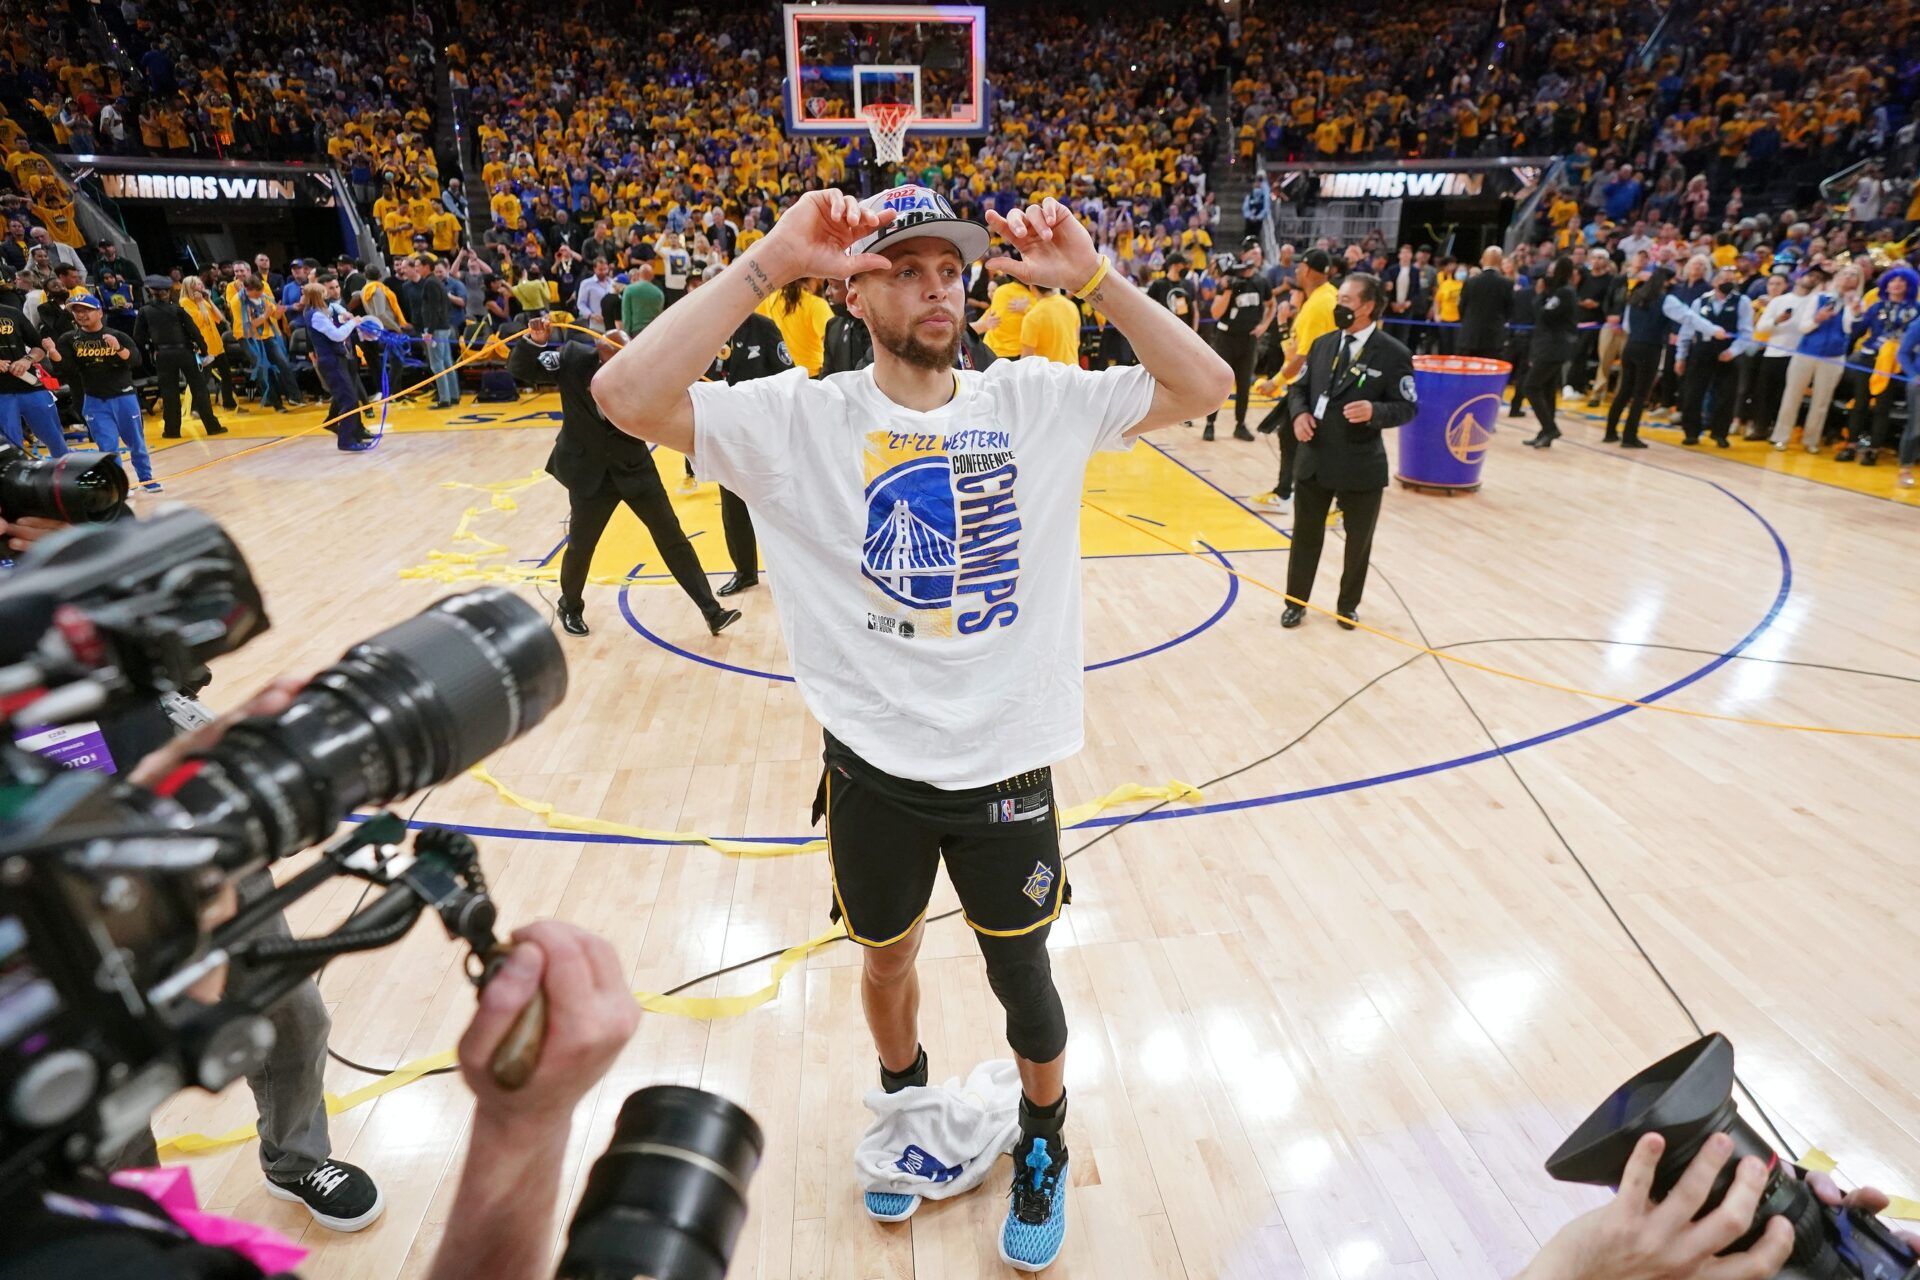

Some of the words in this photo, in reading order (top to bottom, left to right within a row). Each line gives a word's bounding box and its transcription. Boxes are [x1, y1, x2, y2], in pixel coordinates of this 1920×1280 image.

[100, 173, 218, 199] WARRIORS
[218, 178, 295, 199] WIN
[885, 188, 916, 201] 2022
[1406, 173, 1484, 197] WIN
[883, 196, 935, 213] NBA
[941, 429, 1010, 451] WESTERN
[952, 450, 1016, 475] CONFERENCE
[956, 463, 1023, 635] CHAMPS
